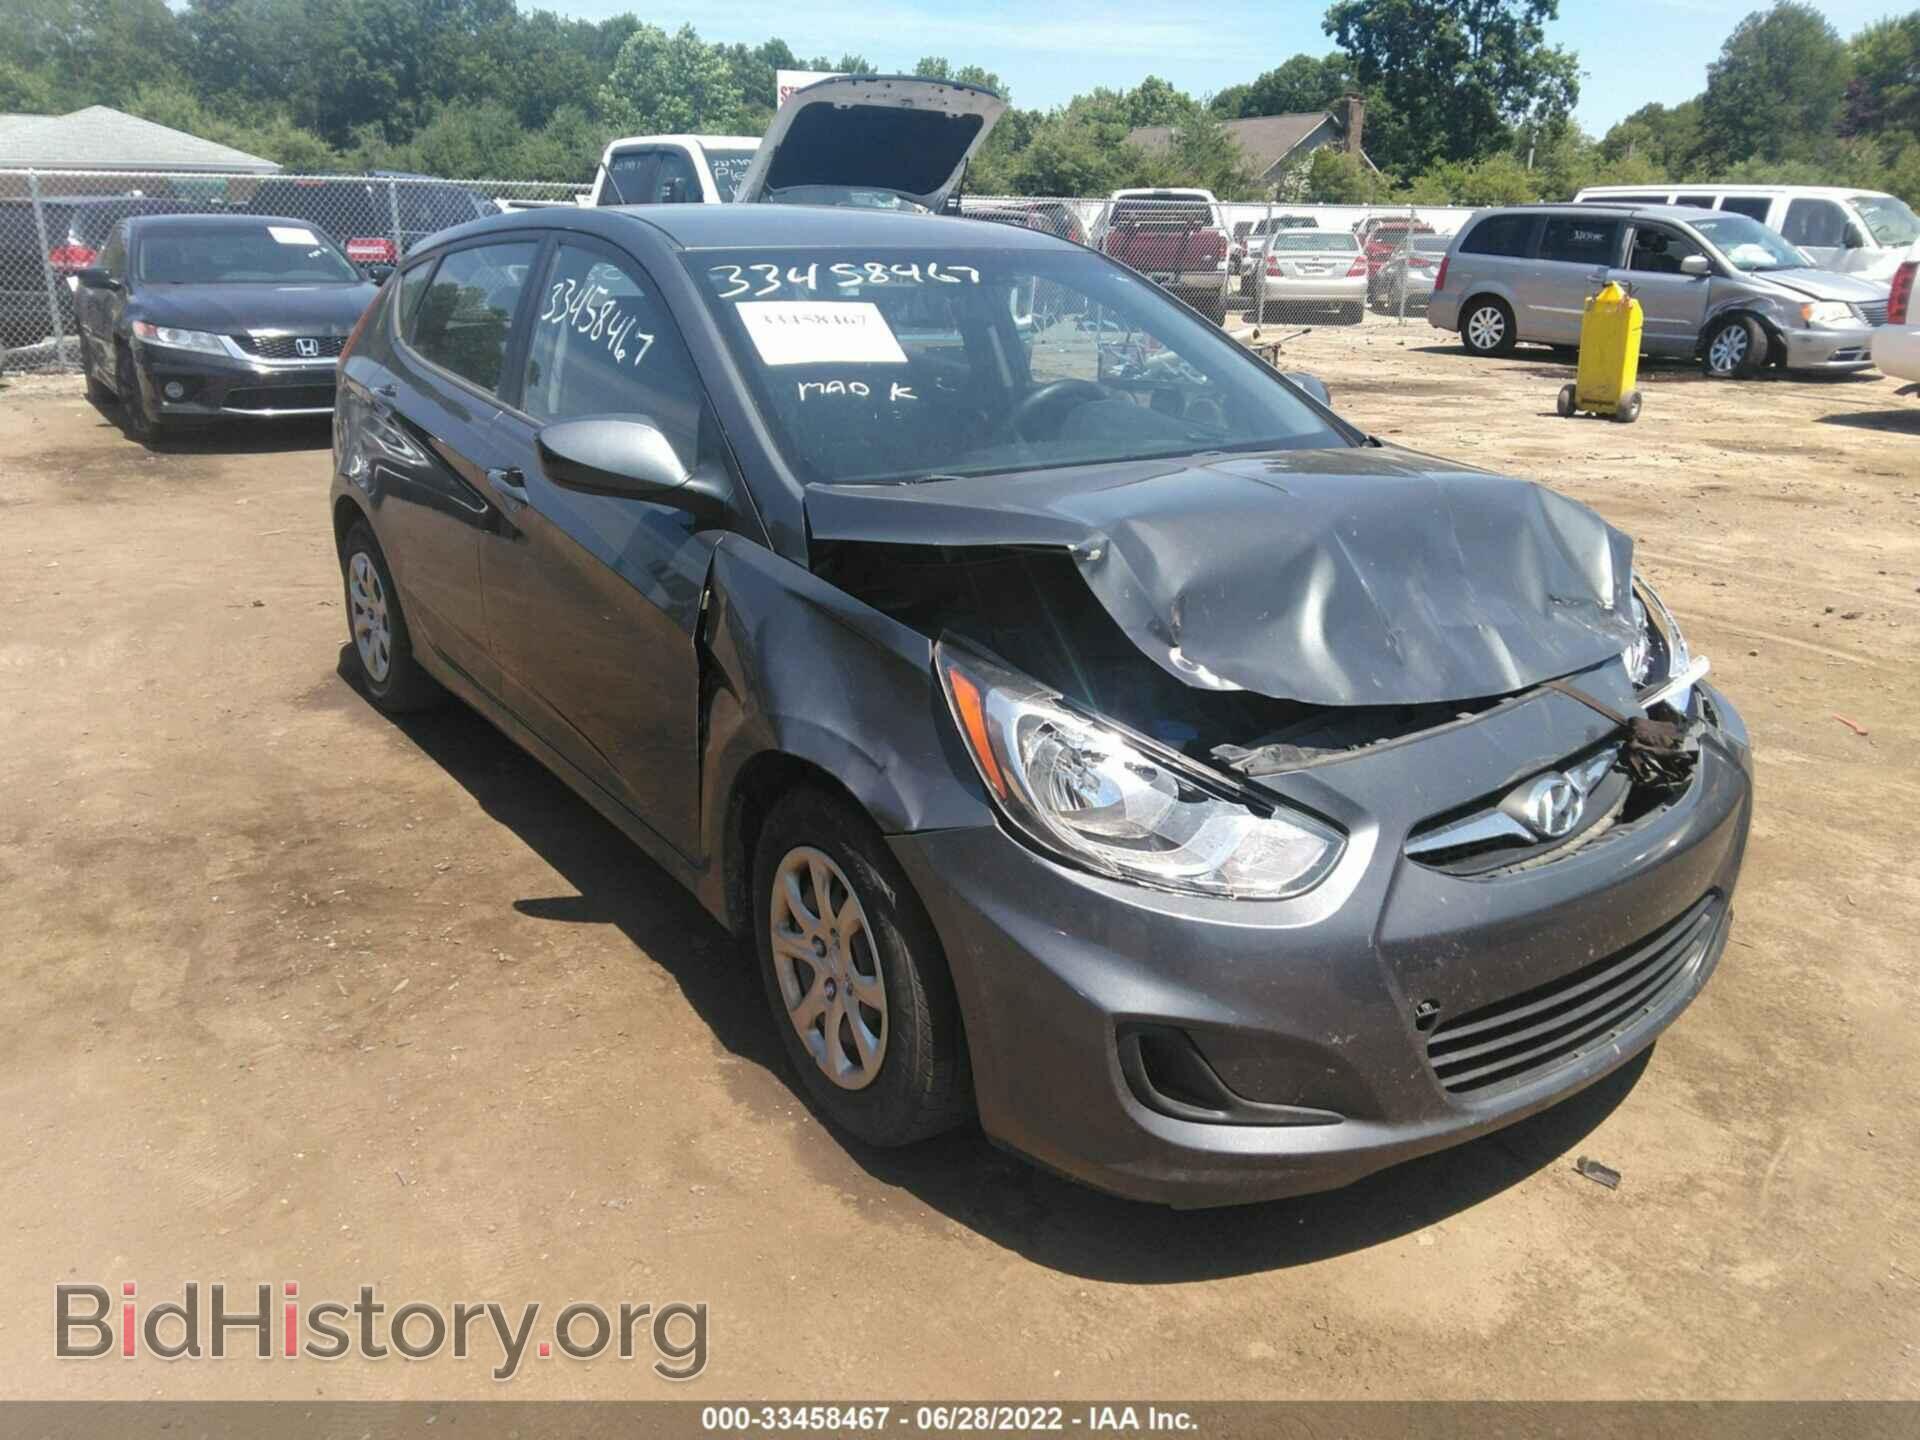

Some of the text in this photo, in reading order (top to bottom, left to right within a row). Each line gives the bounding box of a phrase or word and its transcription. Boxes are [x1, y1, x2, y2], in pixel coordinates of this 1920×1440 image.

[711, 262, 980, 298] 33458467
[541, 278, 654, 366] 33458467
[890, 382, 918, 401] K
